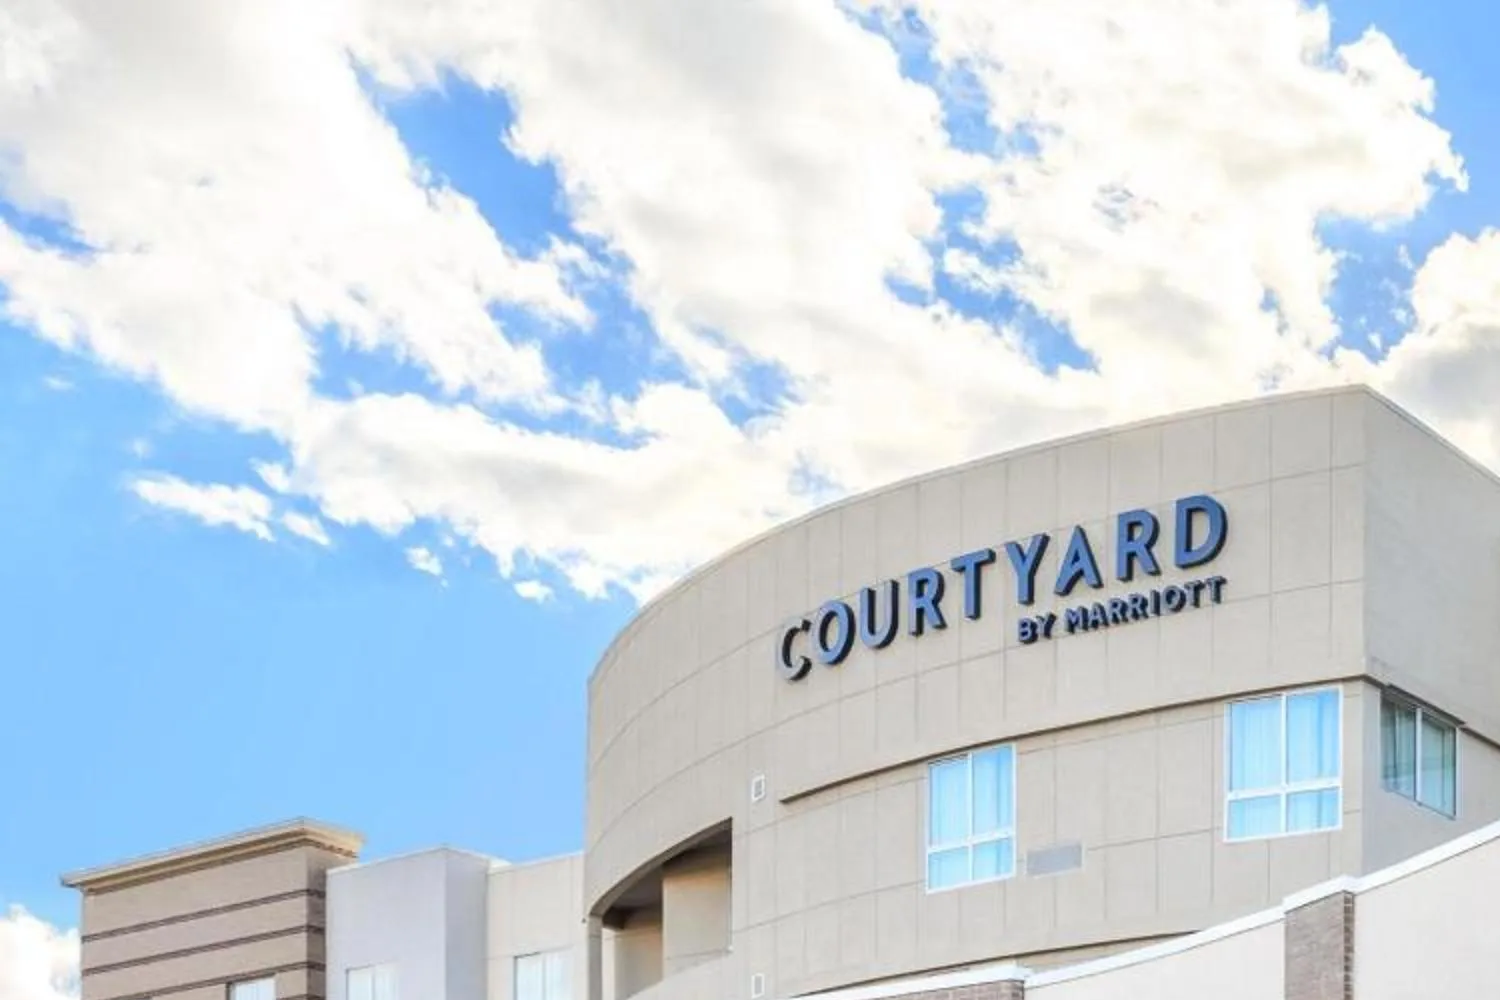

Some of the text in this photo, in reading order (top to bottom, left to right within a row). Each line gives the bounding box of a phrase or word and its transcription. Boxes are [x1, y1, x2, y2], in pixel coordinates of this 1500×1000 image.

[776, 494, 1228, 681] COURTYARD
[1018, 575, 1227, 644] BY MARRIOTT
